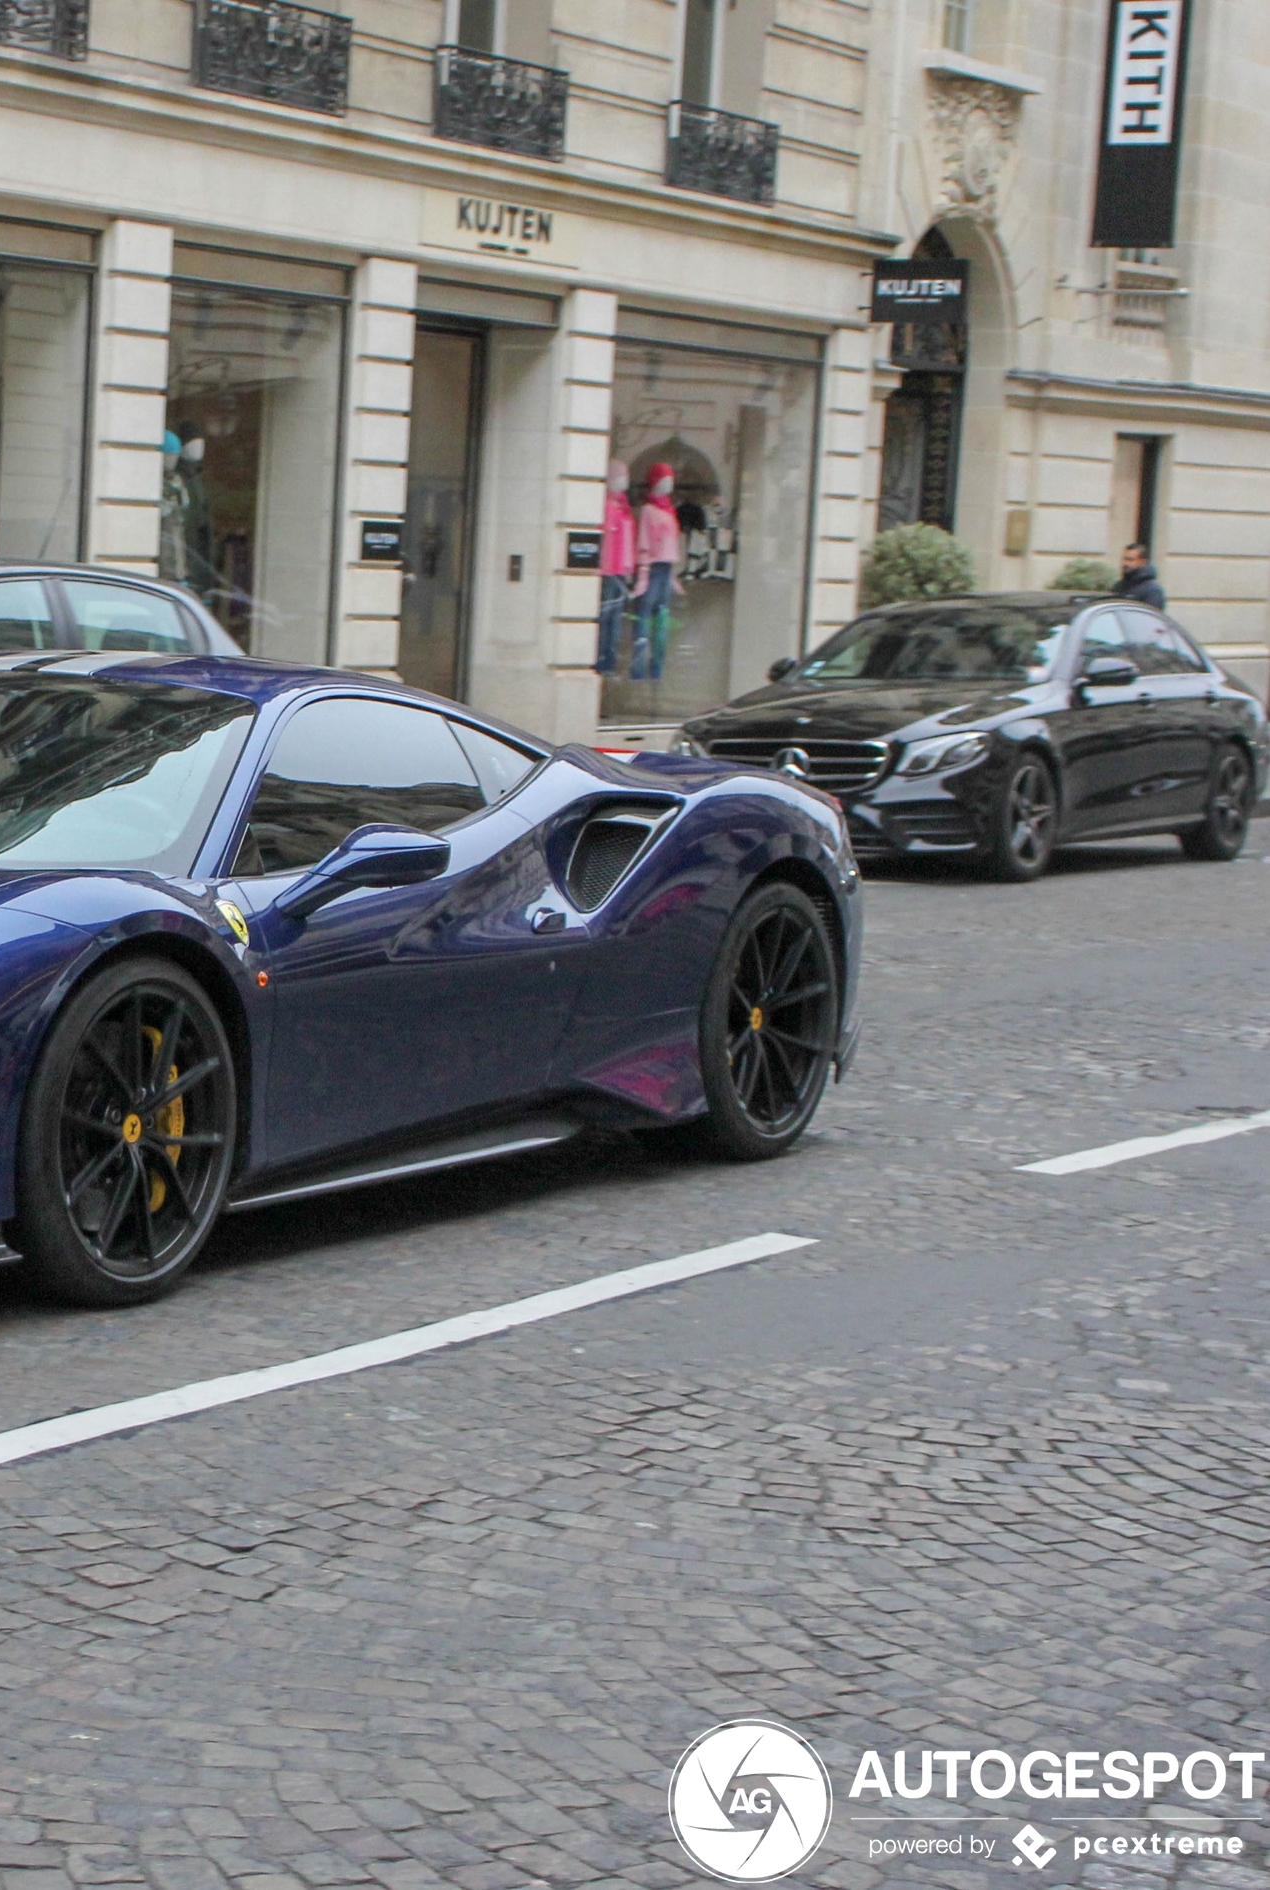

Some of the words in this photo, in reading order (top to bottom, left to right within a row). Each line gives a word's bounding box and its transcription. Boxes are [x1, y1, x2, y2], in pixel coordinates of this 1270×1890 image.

[1121, 10, 1170, 134] KITH
[457, 197, 553, 242] KUJTEN
[877, 279, 962, 296] KUJTEN
